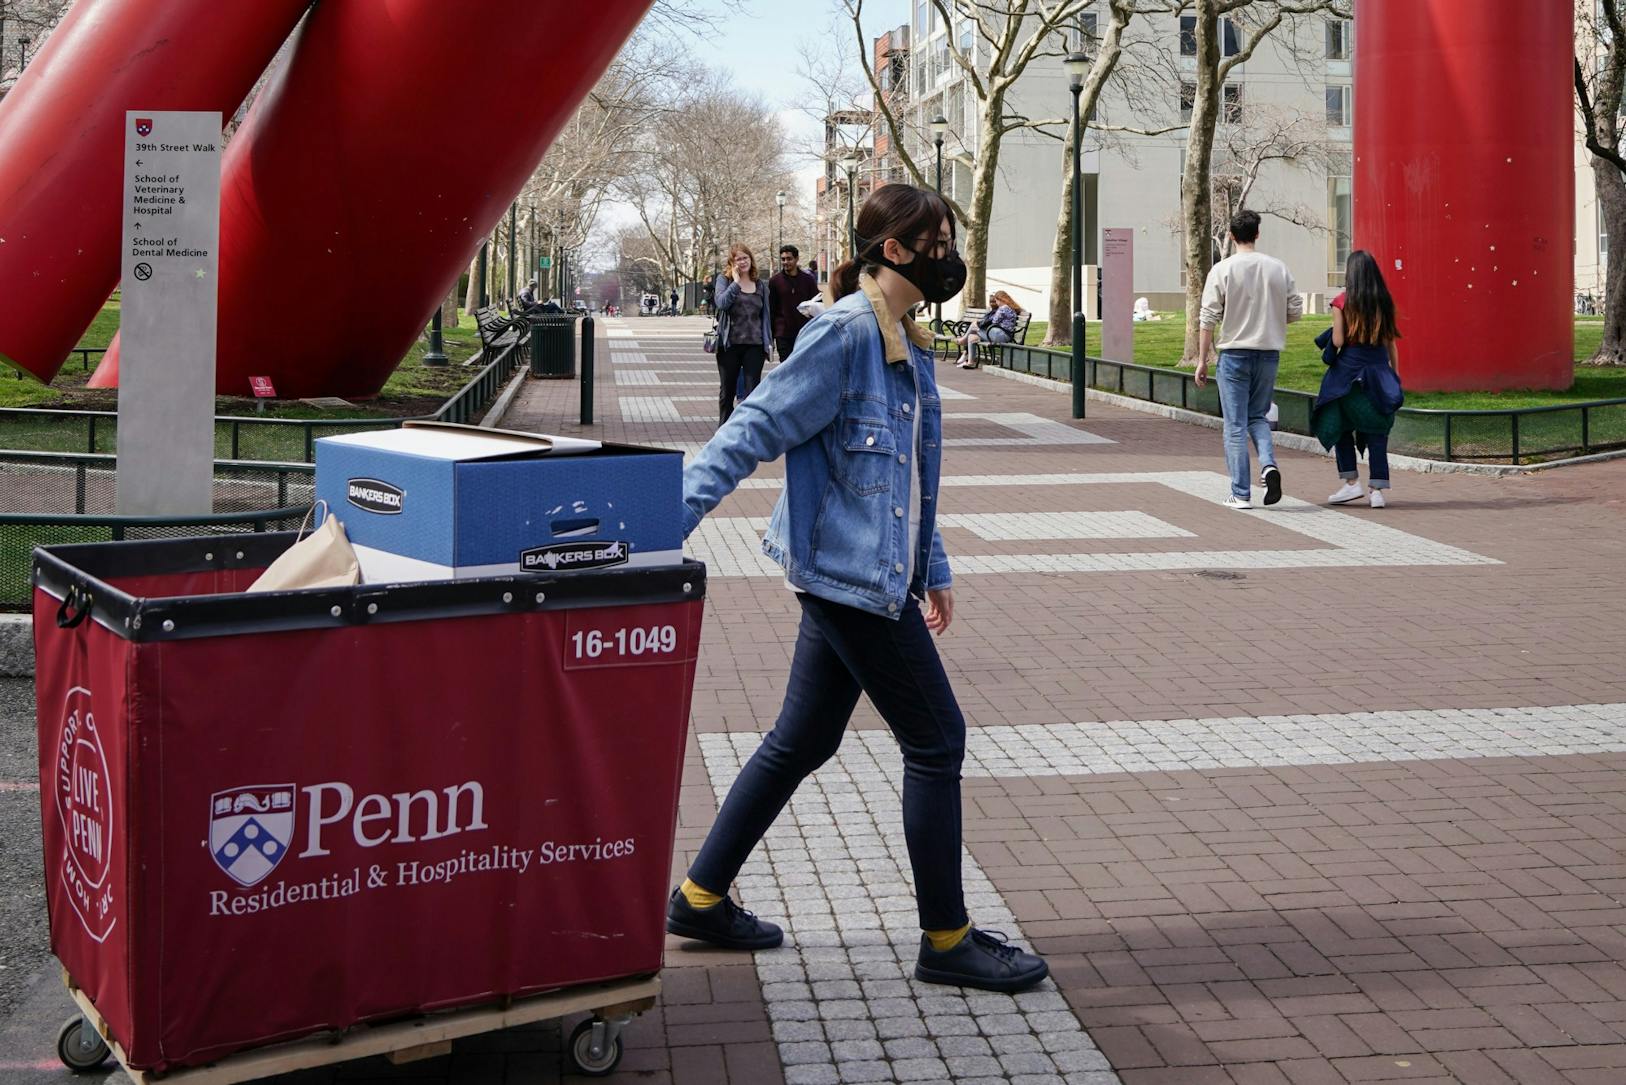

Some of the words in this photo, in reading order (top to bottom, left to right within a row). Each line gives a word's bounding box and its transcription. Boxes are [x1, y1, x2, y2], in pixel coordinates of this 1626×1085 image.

[135, 143, 157, 152] 39th
[160, 143, 189, 152] Street
[193, 144, 216, 152] Walk
[134, 174, 166, 183] School
[168, 174, 180, 183] of
[134, 185, 185, 195] Veterinary
[133, 196, 176, 205] Medicine
[178, 196, 186, 205] &
[133, 206, 172, 216] Hospital
[132, 237, 165, 247] School
[167, 237, 178, 247] of
[132, 248, 164, 257] Dental
[166, 248, 208, 258] Medicine
[349, 485, 384, 503] BANKERS
[383, 492, 401, 507] BOX
[525, 550, 593, 567] BAKERS
[572, 625, 677, 659] 16-1049
[74, 762, 99, 813] LIVE
[298, 779, 489, 859] Penn
[72, 809, 102, 864] PENN
[209, 867, 360, 916] Residential
[366, 864, 389, 889] &
[396, 844, 534, 886] Hospitality
[539, 836, 636, 865] Services
